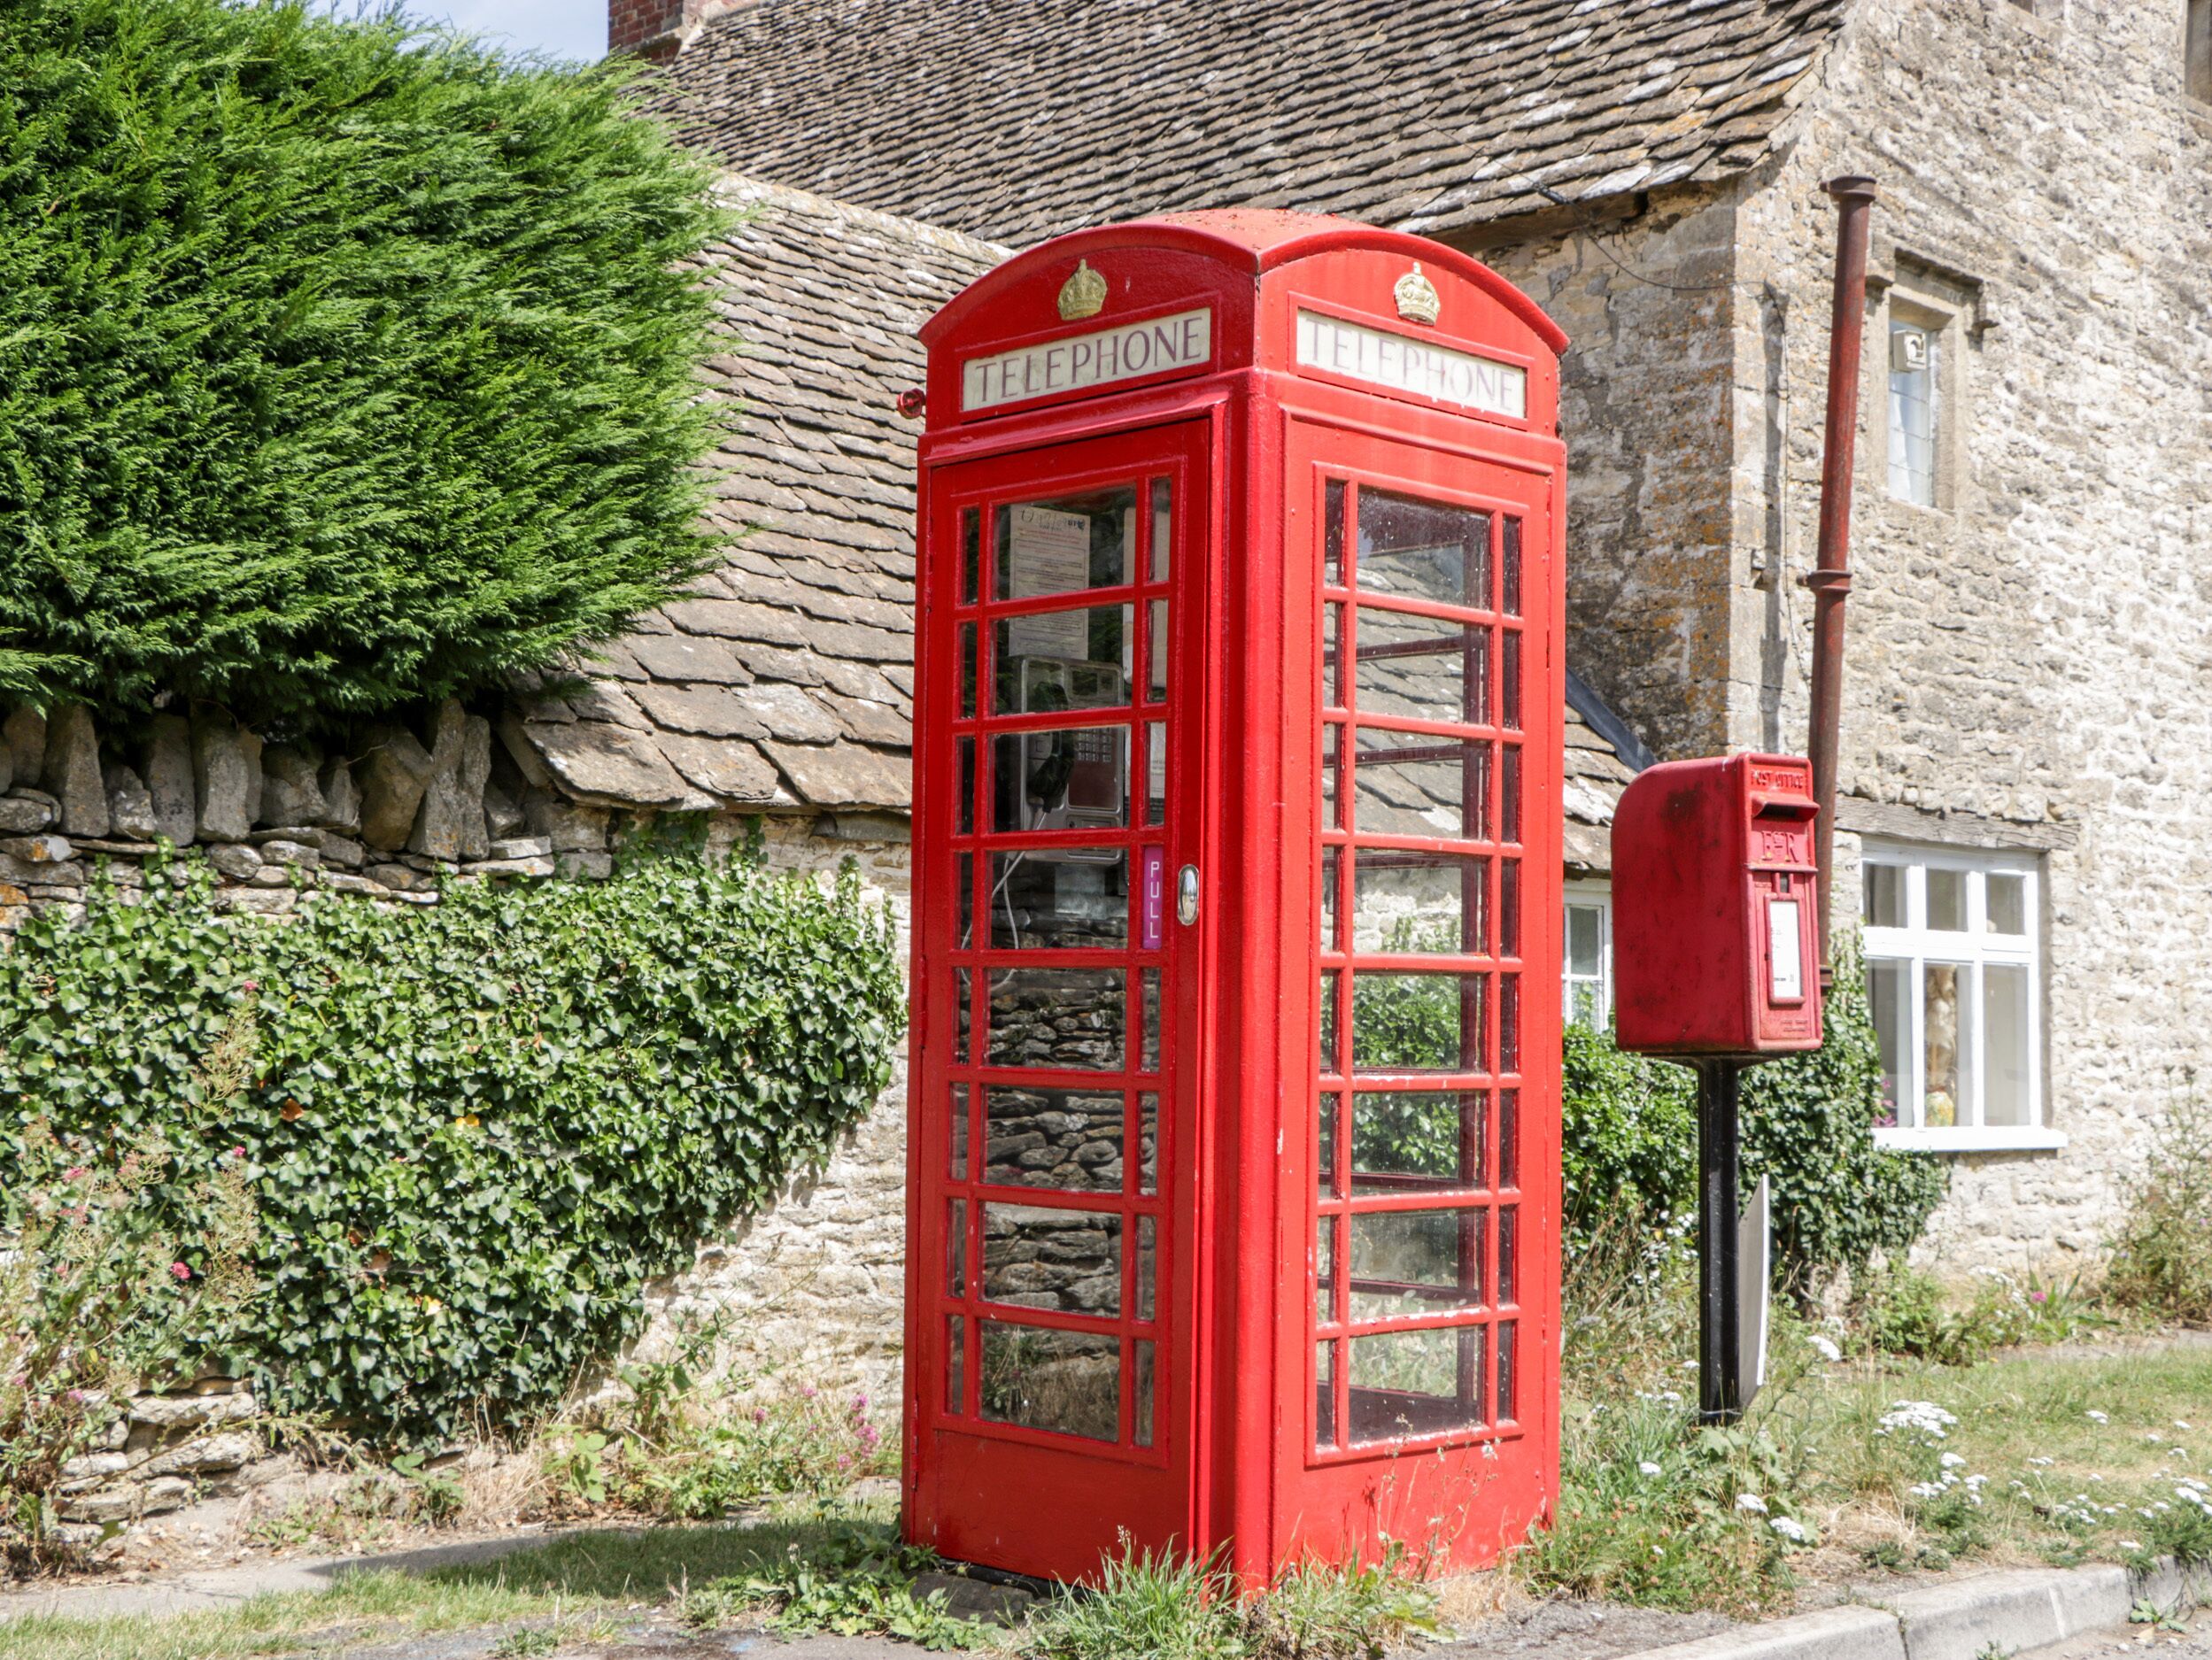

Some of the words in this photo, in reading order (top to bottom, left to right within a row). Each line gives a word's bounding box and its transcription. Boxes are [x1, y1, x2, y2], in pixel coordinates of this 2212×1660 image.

[975, 316, 1203, 402] TELEPHONE
[1305, 318, 1516, 411] TELEPHONE
[1150, 861, 1160, 938] PULL
